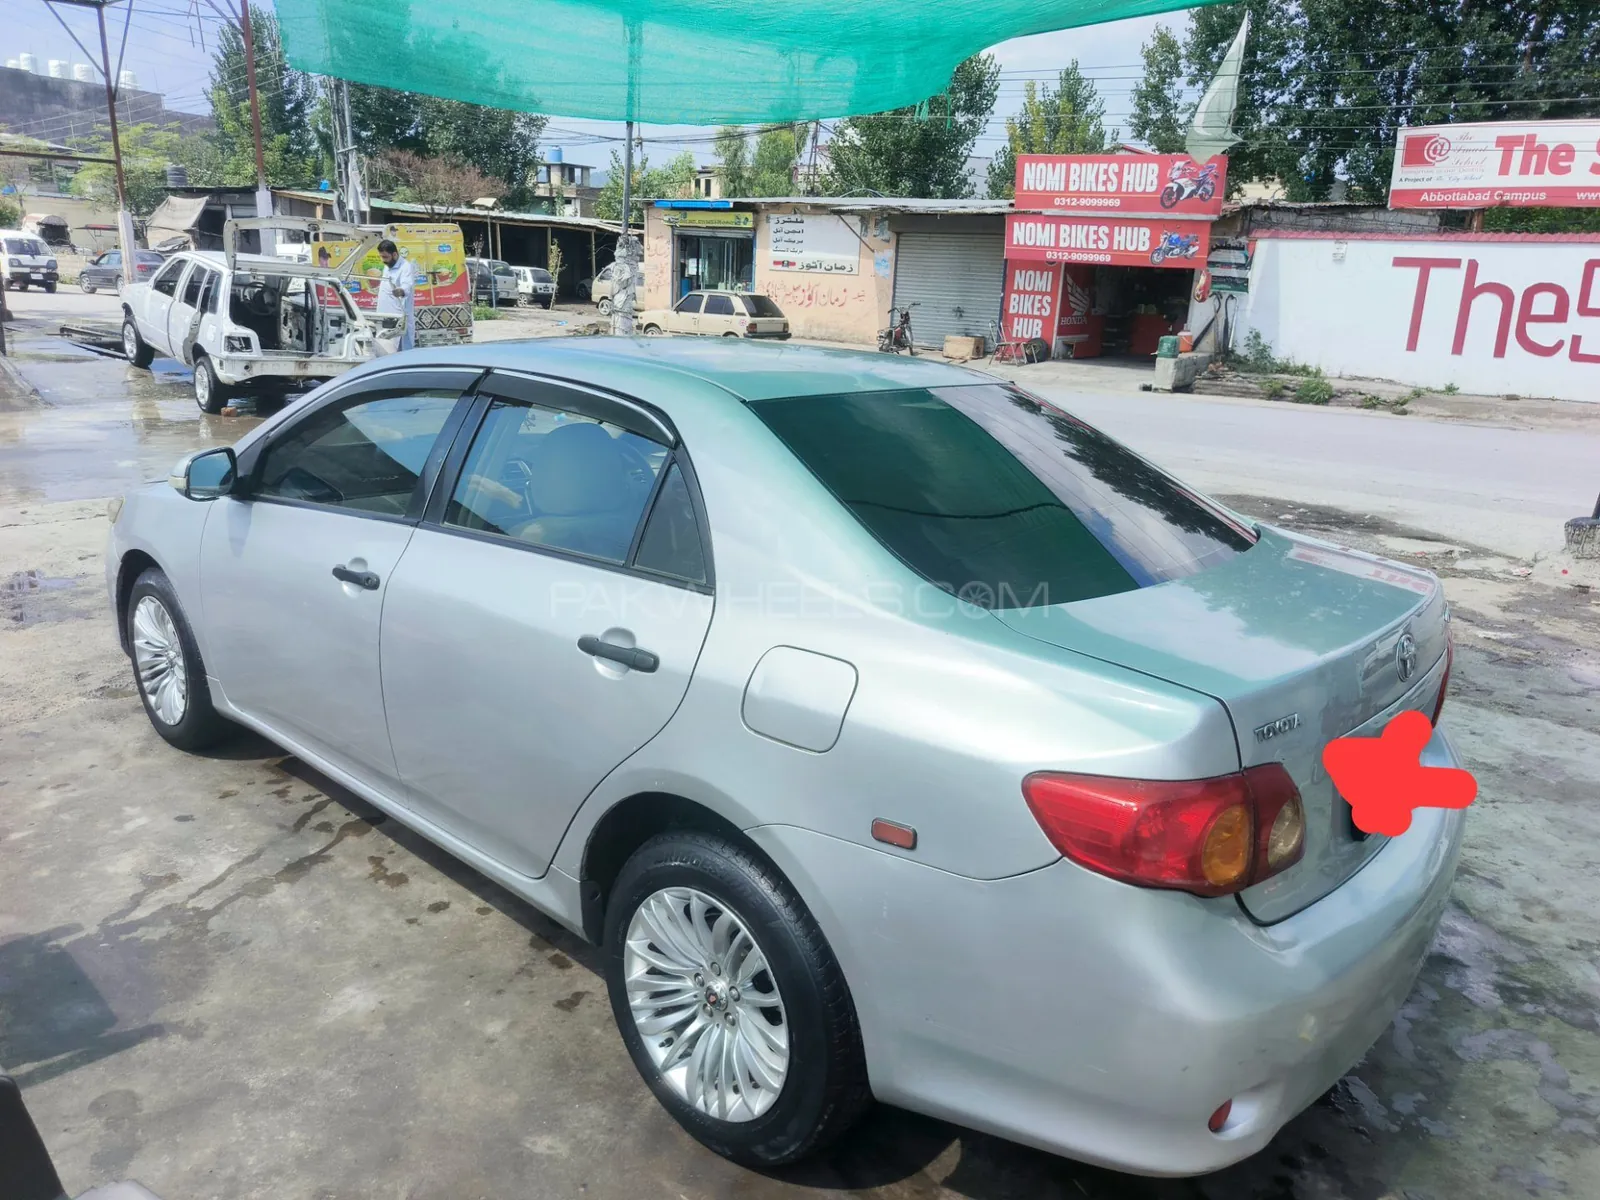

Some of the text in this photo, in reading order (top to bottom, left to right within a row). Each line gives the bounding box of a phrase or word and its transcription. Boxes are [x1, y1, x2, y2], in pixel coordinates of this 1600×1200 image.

[1495, 133, 1576, 176] The
[1023, 162, 1160, 193] NOMI BIKES HUB
[1054, 197, 1120, 208] 0312-9099969
[1420, 191, 1491, 202] Abbottabad
[1494, 190, 1547, 203] Campus
[1012, 221, 1151, 251] NOMI BIKES HUB
[824, 262, 853, 273] زمان
[1046, 251, 1111, 262] 0312-9099969
[1013, 269, 1053, 292] NOMI
[1009, 293, 1051, 316] BIKES
[1012, 318, 1042, 339] HUB
[1060, 316, 1088, 325] HONDA
[1253, 712, 1301, 744] TOYOTA
